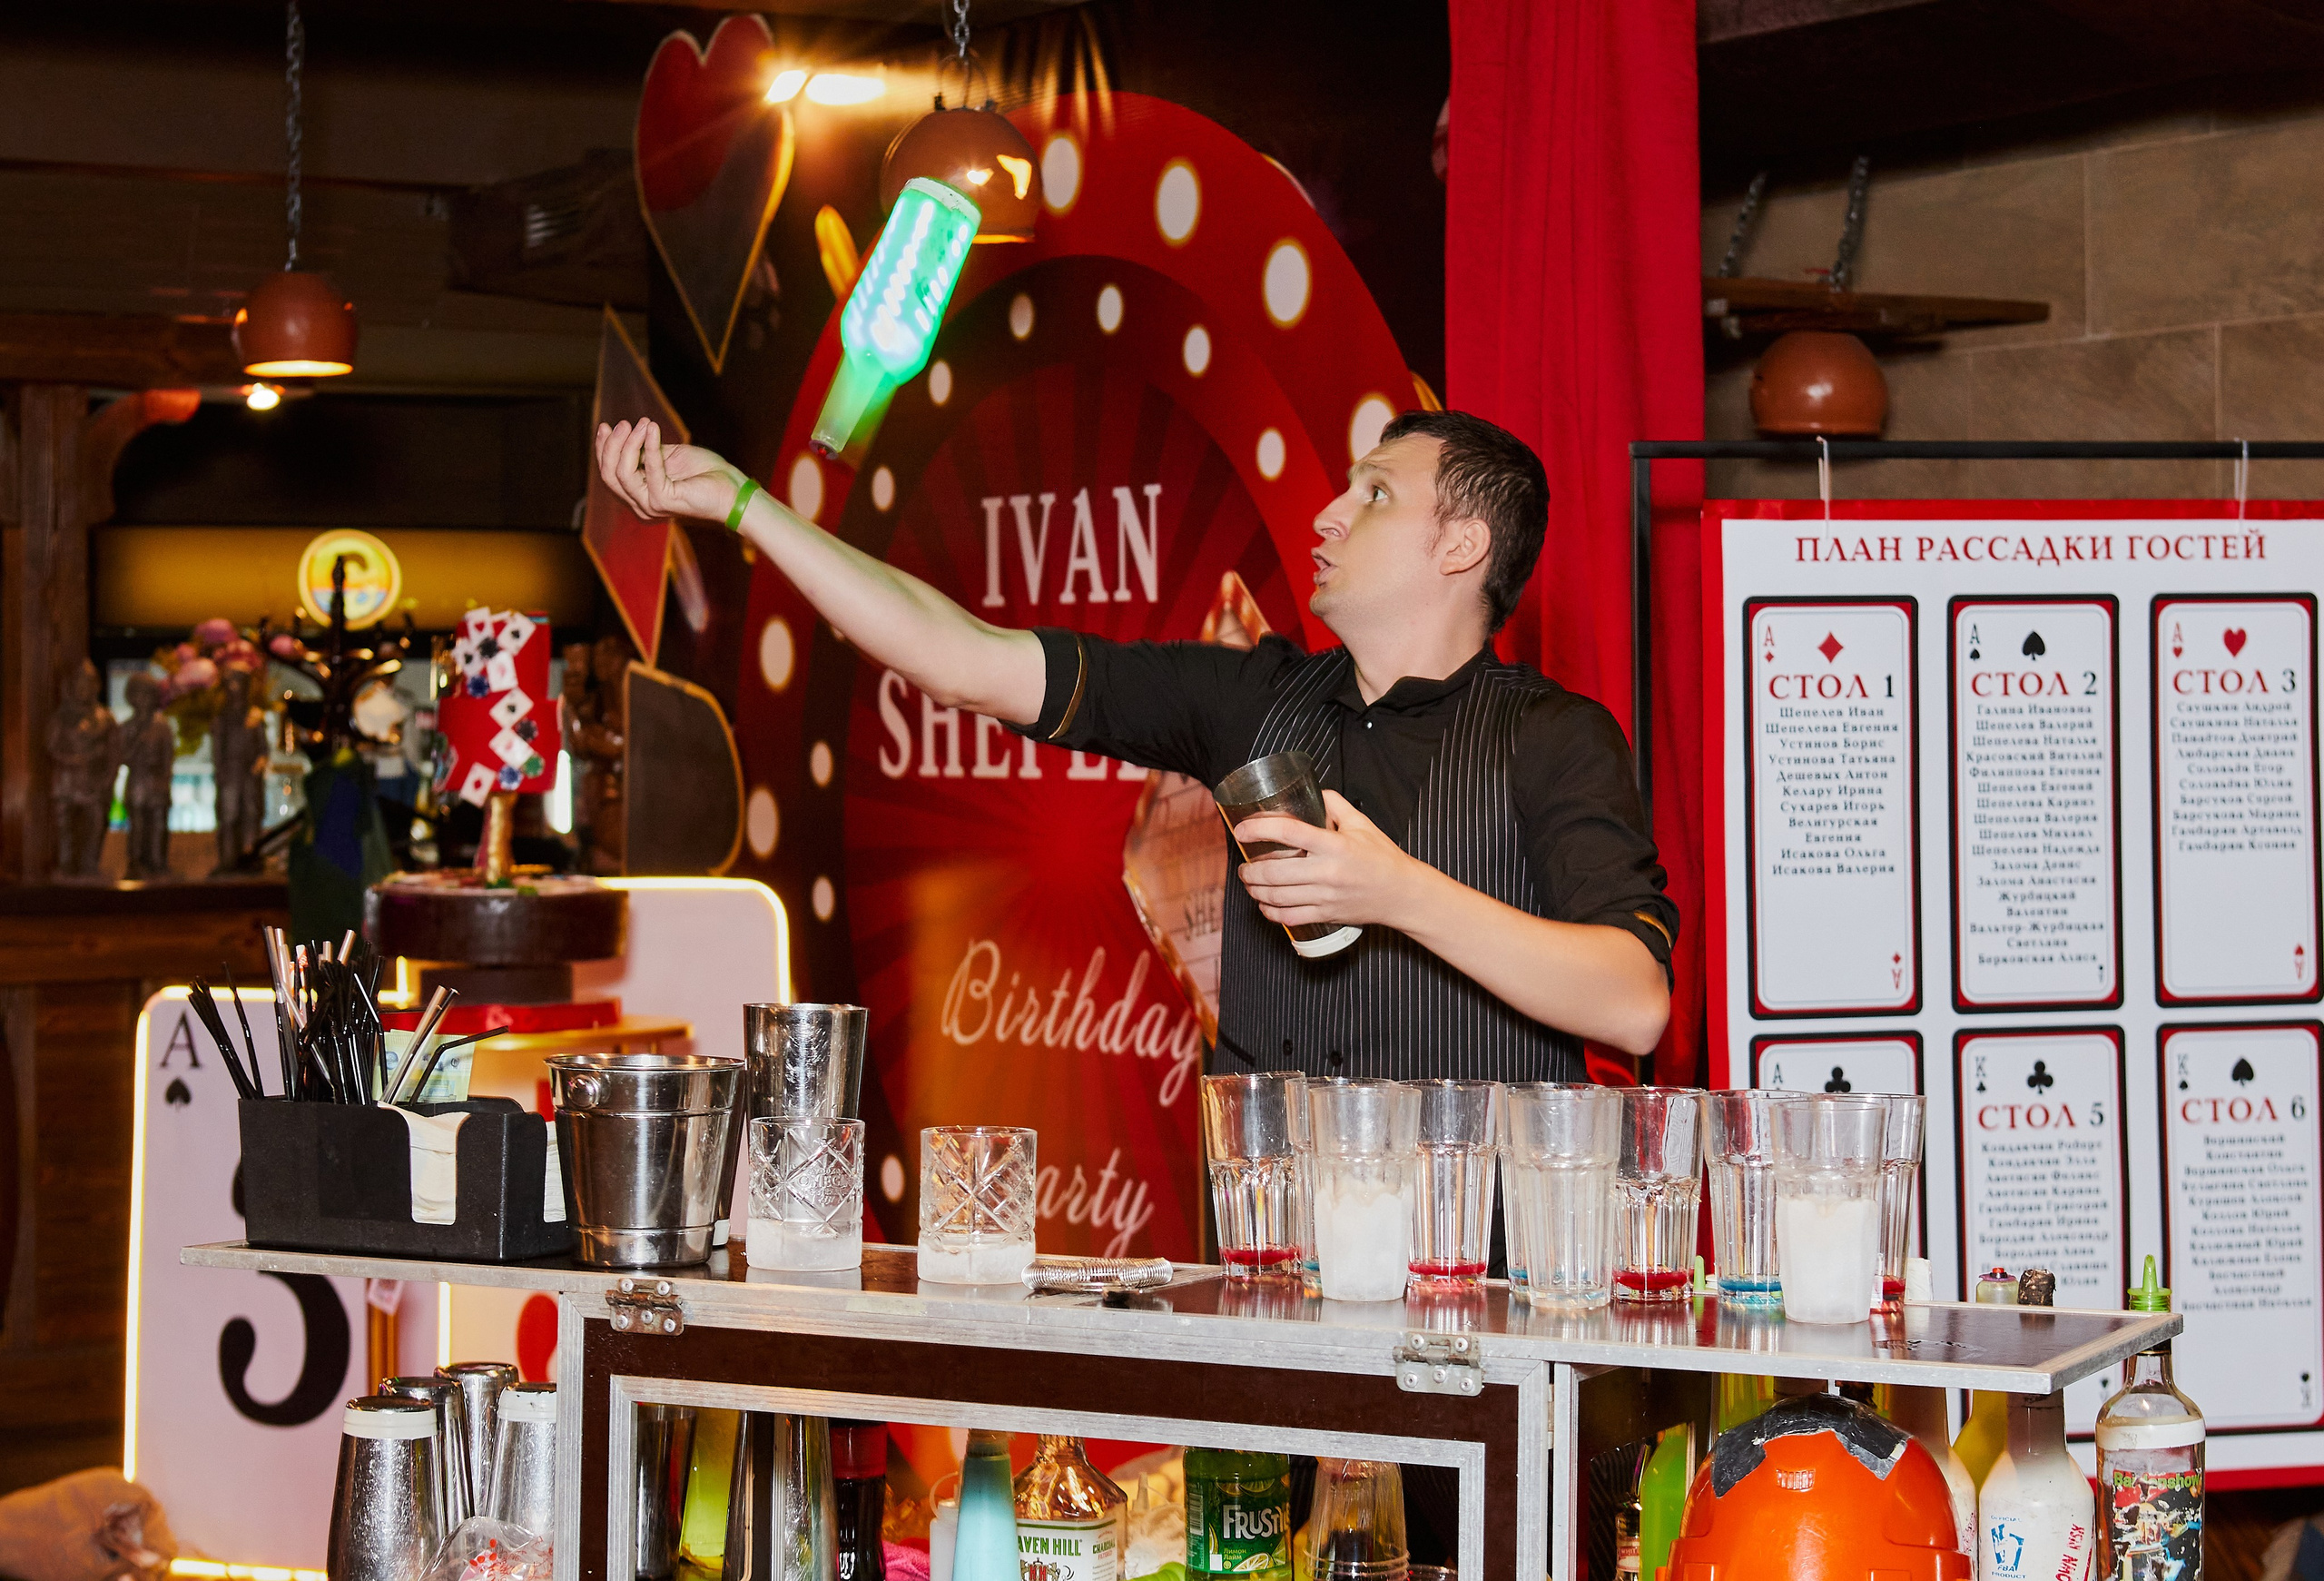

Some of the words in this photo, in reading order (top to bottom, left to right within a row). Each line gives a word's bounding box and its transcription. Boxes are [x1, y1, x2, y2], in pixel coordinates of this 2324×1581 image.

[981, 484, 1162, 608] IVAN
[1796, 538, 1901, 561] ПЛАН
[1915, 536, 2112, 566] РАССАДКИ
[2128, 529, 2266, 560] ГОСТЕЙ
[1768, 674, 1869, 699] СТОЛ
[1885, 674, 1895, 698] 1
[1972, 671, 2069, 697] СТОЛ
[2083, 671, 2097, 695] 2
[2173, 669, 2269, 695] СТОЛ
[2281, 668, 2295, 693] 3
[941, 939, 1203, 1107] Birthday
[159, 1010, 203, 1071] A
[1978, 1104, 2076, 1131] СТОЛ
[2090, 1102, 2104, 1126] 5
[2181, 1097, 2279, 1123] СТОЛ
[2291, 1095, 2305, 1120] 6
[1053, 1538, 1081, 1556] HILL
